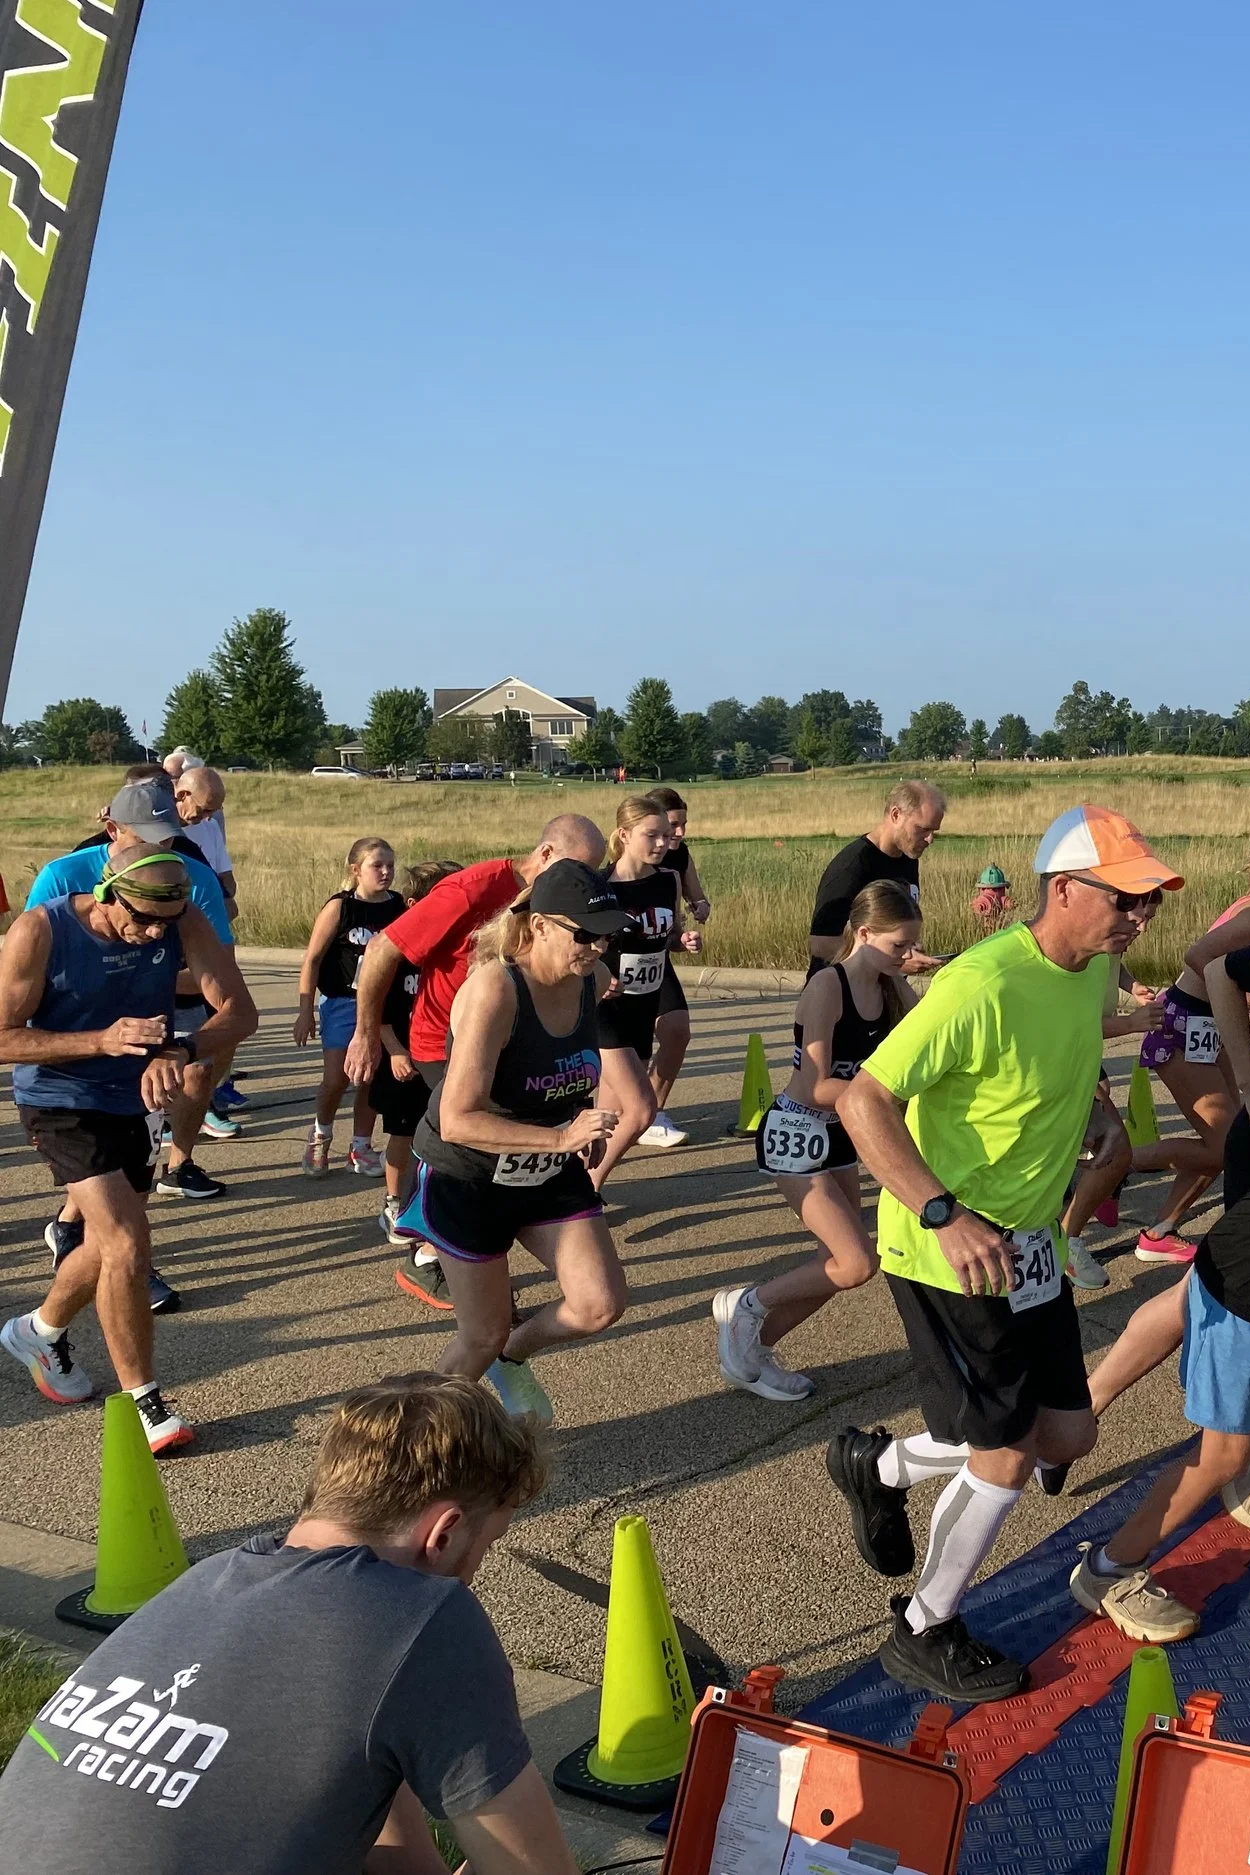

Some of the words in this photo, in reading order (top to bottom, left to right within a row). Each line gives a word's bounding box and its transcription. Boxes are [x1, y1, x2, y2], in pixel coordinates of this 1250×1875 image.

[622, 962, 664, 986] 5401
[554, 1051, 583, 1073] THE
[525, 1066, 586, 1091] NORTH
[544, 1077, 586, 1102] FACE
[779, 1116, 812, 1129] ShaZam
[766, 1128, 825, 1161] 5330
[36, 1665, 230, 1771] haZam
[62, 1741, 201, 1809] racing
